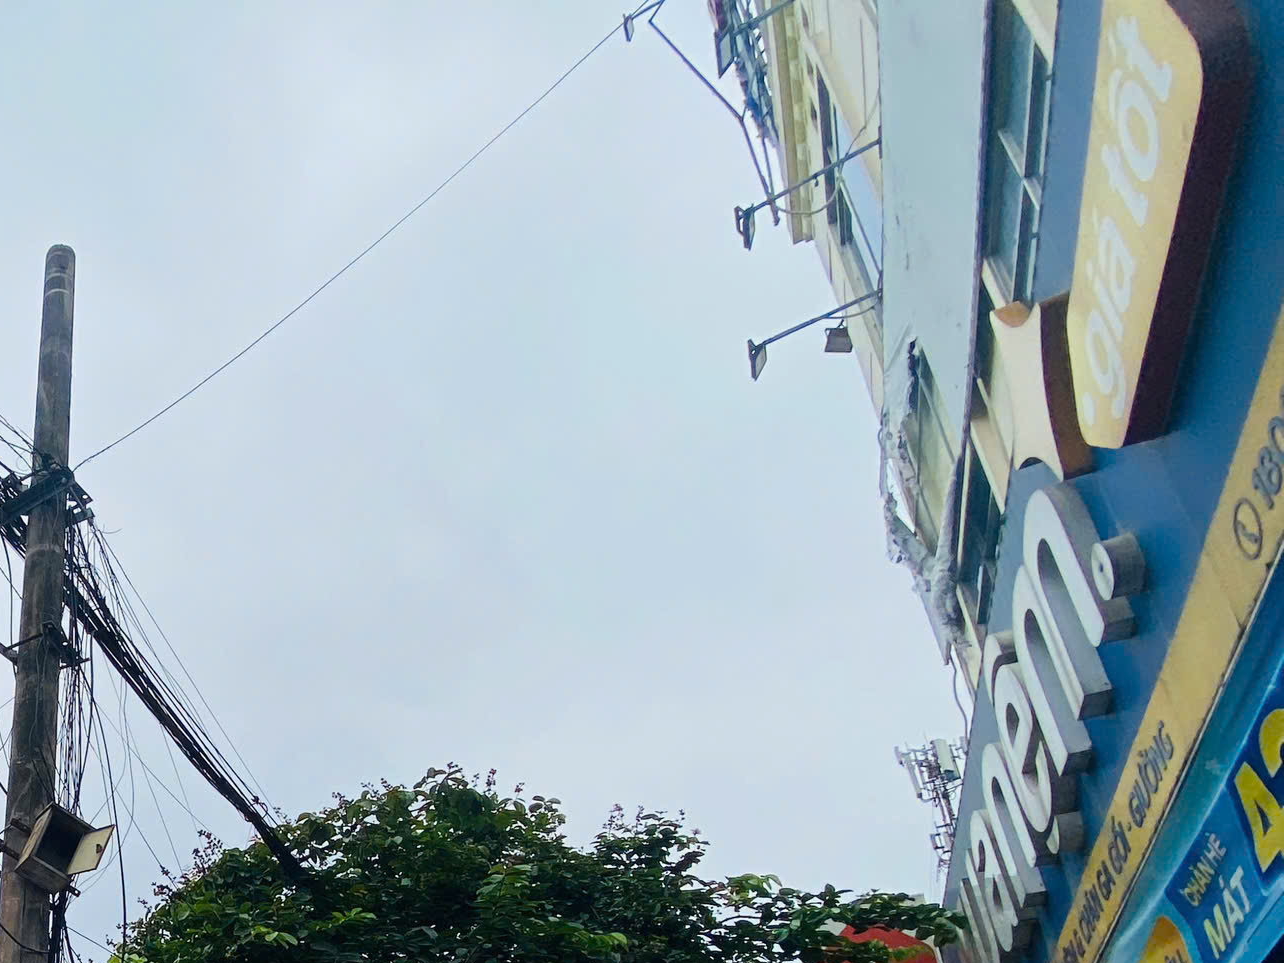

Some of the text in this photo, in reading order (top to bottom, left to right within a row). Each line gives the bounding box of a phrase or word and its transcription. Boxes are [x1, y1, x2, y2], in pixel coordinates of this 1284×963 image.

[1085, 14, 1174, 419] giá tốt
[1096, 860, 1116, 900] GA
[1108, 816, 1131, 875] GỐI
[1129, 720, 1174, 828] GIƯỜNG
[1203, 865, 1250, 960] MÁT
